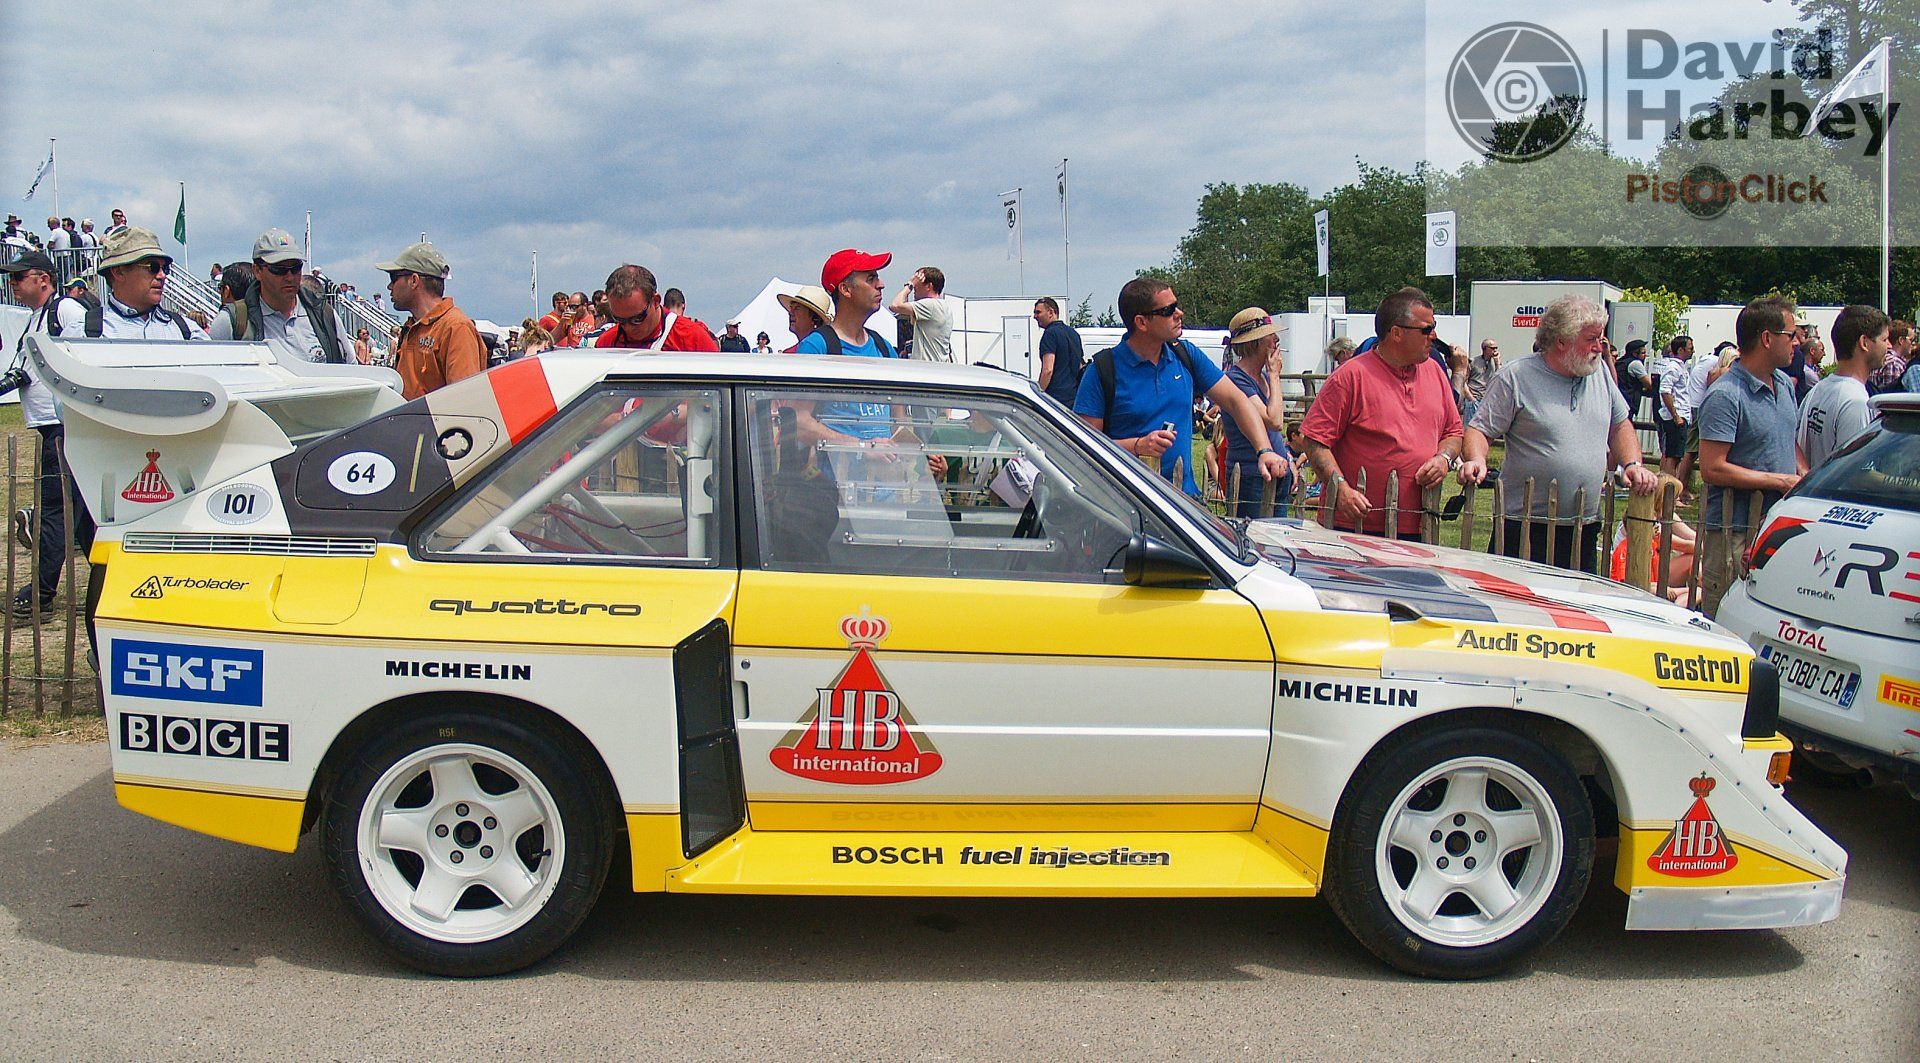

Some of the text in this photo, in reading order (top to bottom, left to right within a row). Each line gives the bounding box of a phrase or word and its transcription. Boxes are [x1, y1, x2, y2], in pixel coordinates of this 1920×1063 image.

[135, 472, 164, 493] HB
[346, 462, 376, 483] 64
[223, 493, 256, 514] 101
[162, 576, 249, 590] Turbolader
[429, 598, 642, 616] quattro
[1457, 629, 1596, 659] Audi Sport
[124, 652, 252, 691] SKF
[385, 660, 532, 680] MICHELIN
[1653, 652, 1740, 685] Castrol
[1278, 679, 1418, 707] MICHELIN
[816, 687, 901, 752] HB
[128, 716, 279, 758] BOGE
[793, 754, 919, 774] international
[1673, 820, 1721, 857] HB
[832, 846, 1170, 868] BOSCH fuel injection
[1659, 859, 1726, 870] international
